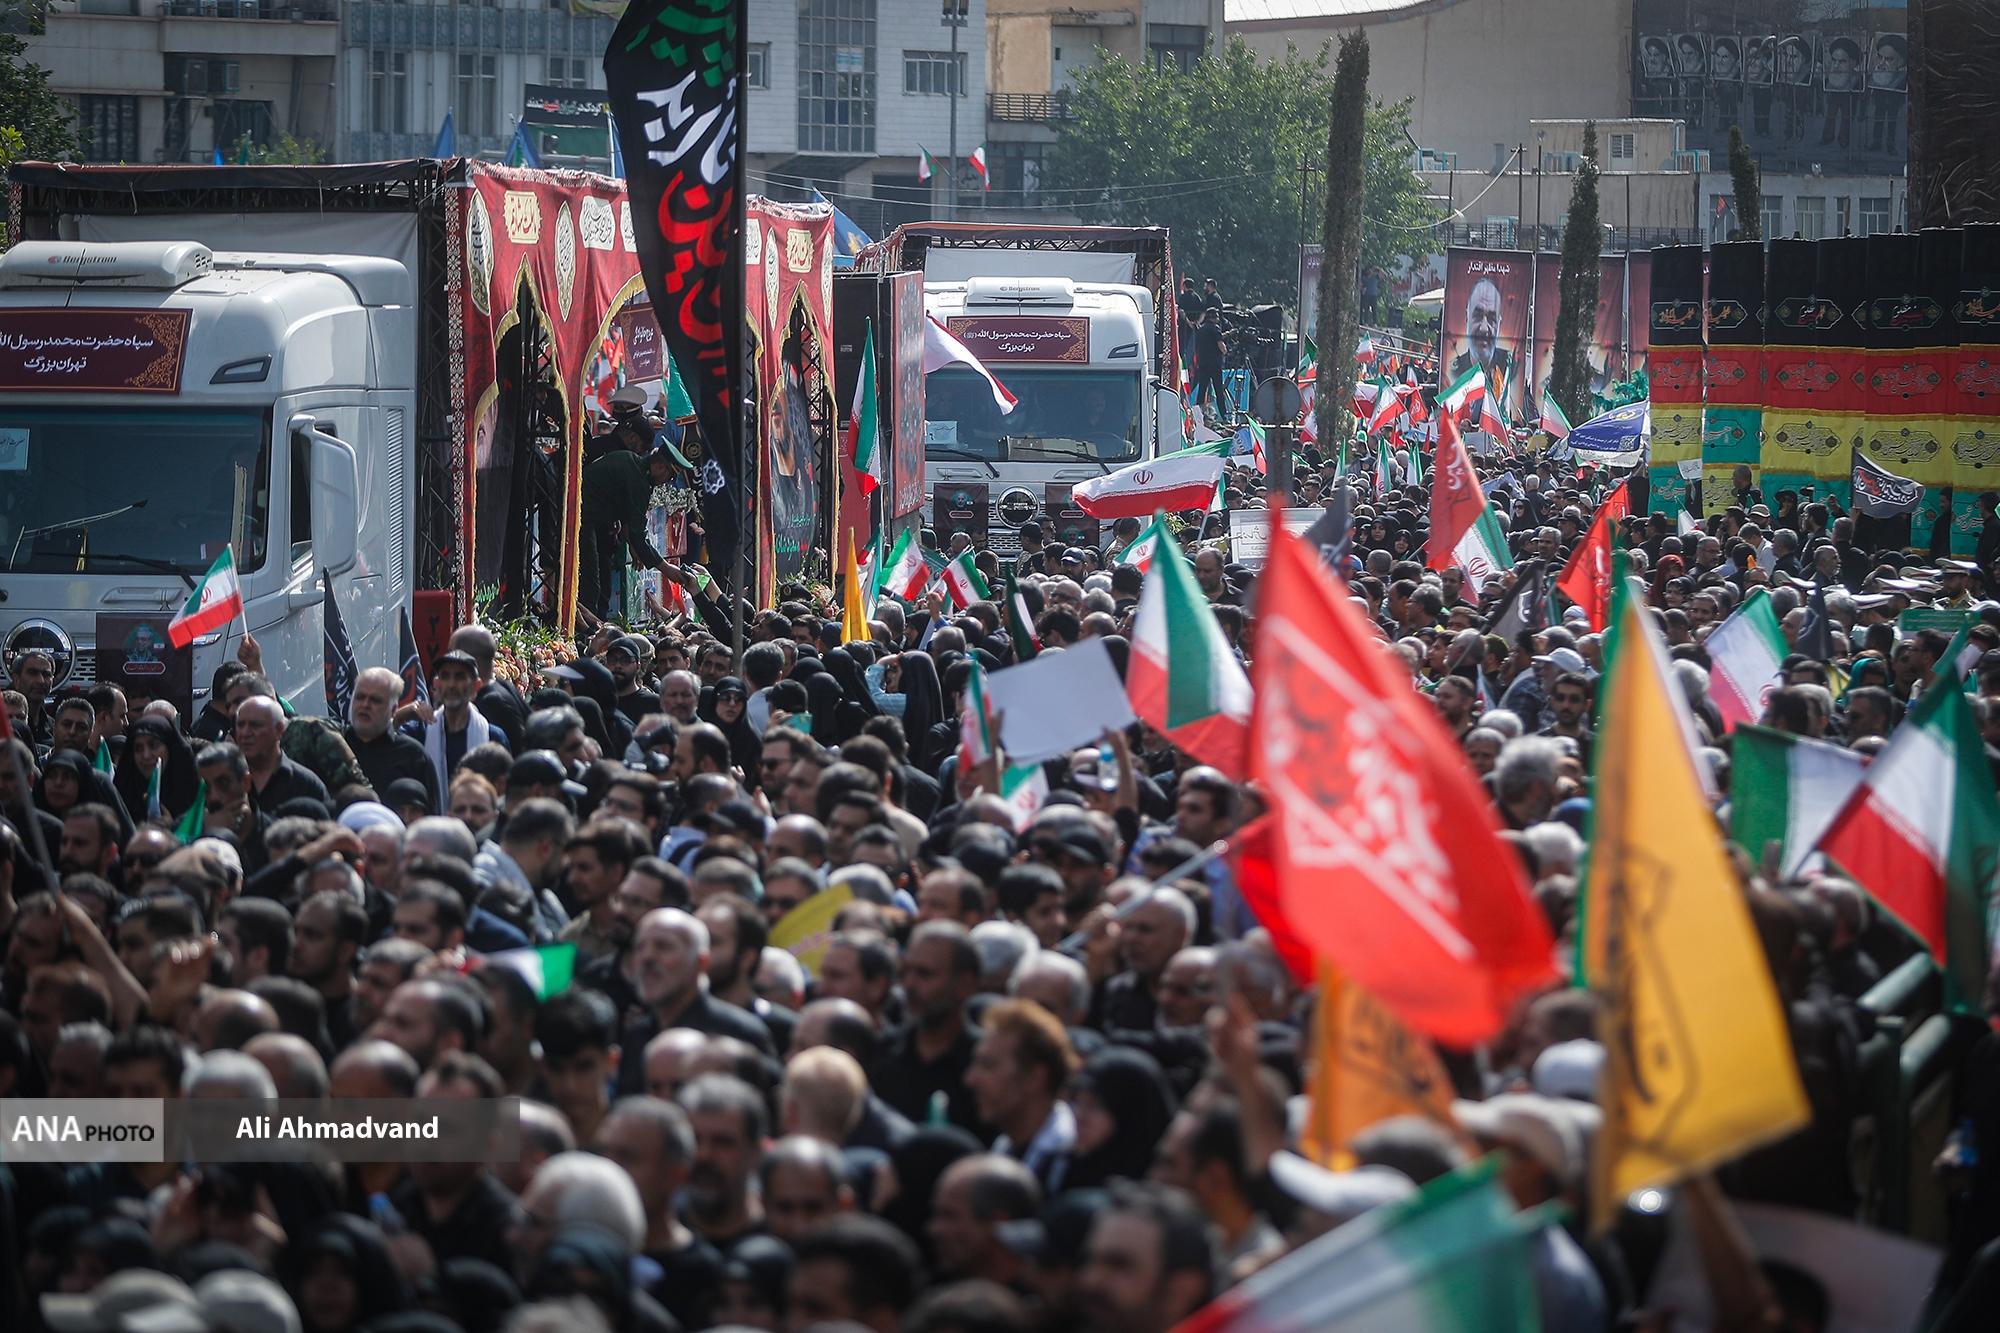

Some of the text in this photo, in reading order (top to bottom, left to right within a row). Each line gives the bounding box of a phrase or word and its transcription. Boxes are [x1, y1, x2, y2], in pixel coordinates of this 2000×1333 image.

[977, 329, 989, 338] الله
[989, 331, 1009, 340] رسول
[1029, 331, 1054, 340] حضرت
[1053, 332, 1071, 340] سپاه
[10, 334, 45, 350] رسول
[45, 336, 82, 347] محمد
[82, 335, 125, 350] حضرت
[124, 335, 154, 350] سپاه
[998, 343, 1035, 353] تهران بزرگ
[24, 355, 87, 373] تهران بزرگ
